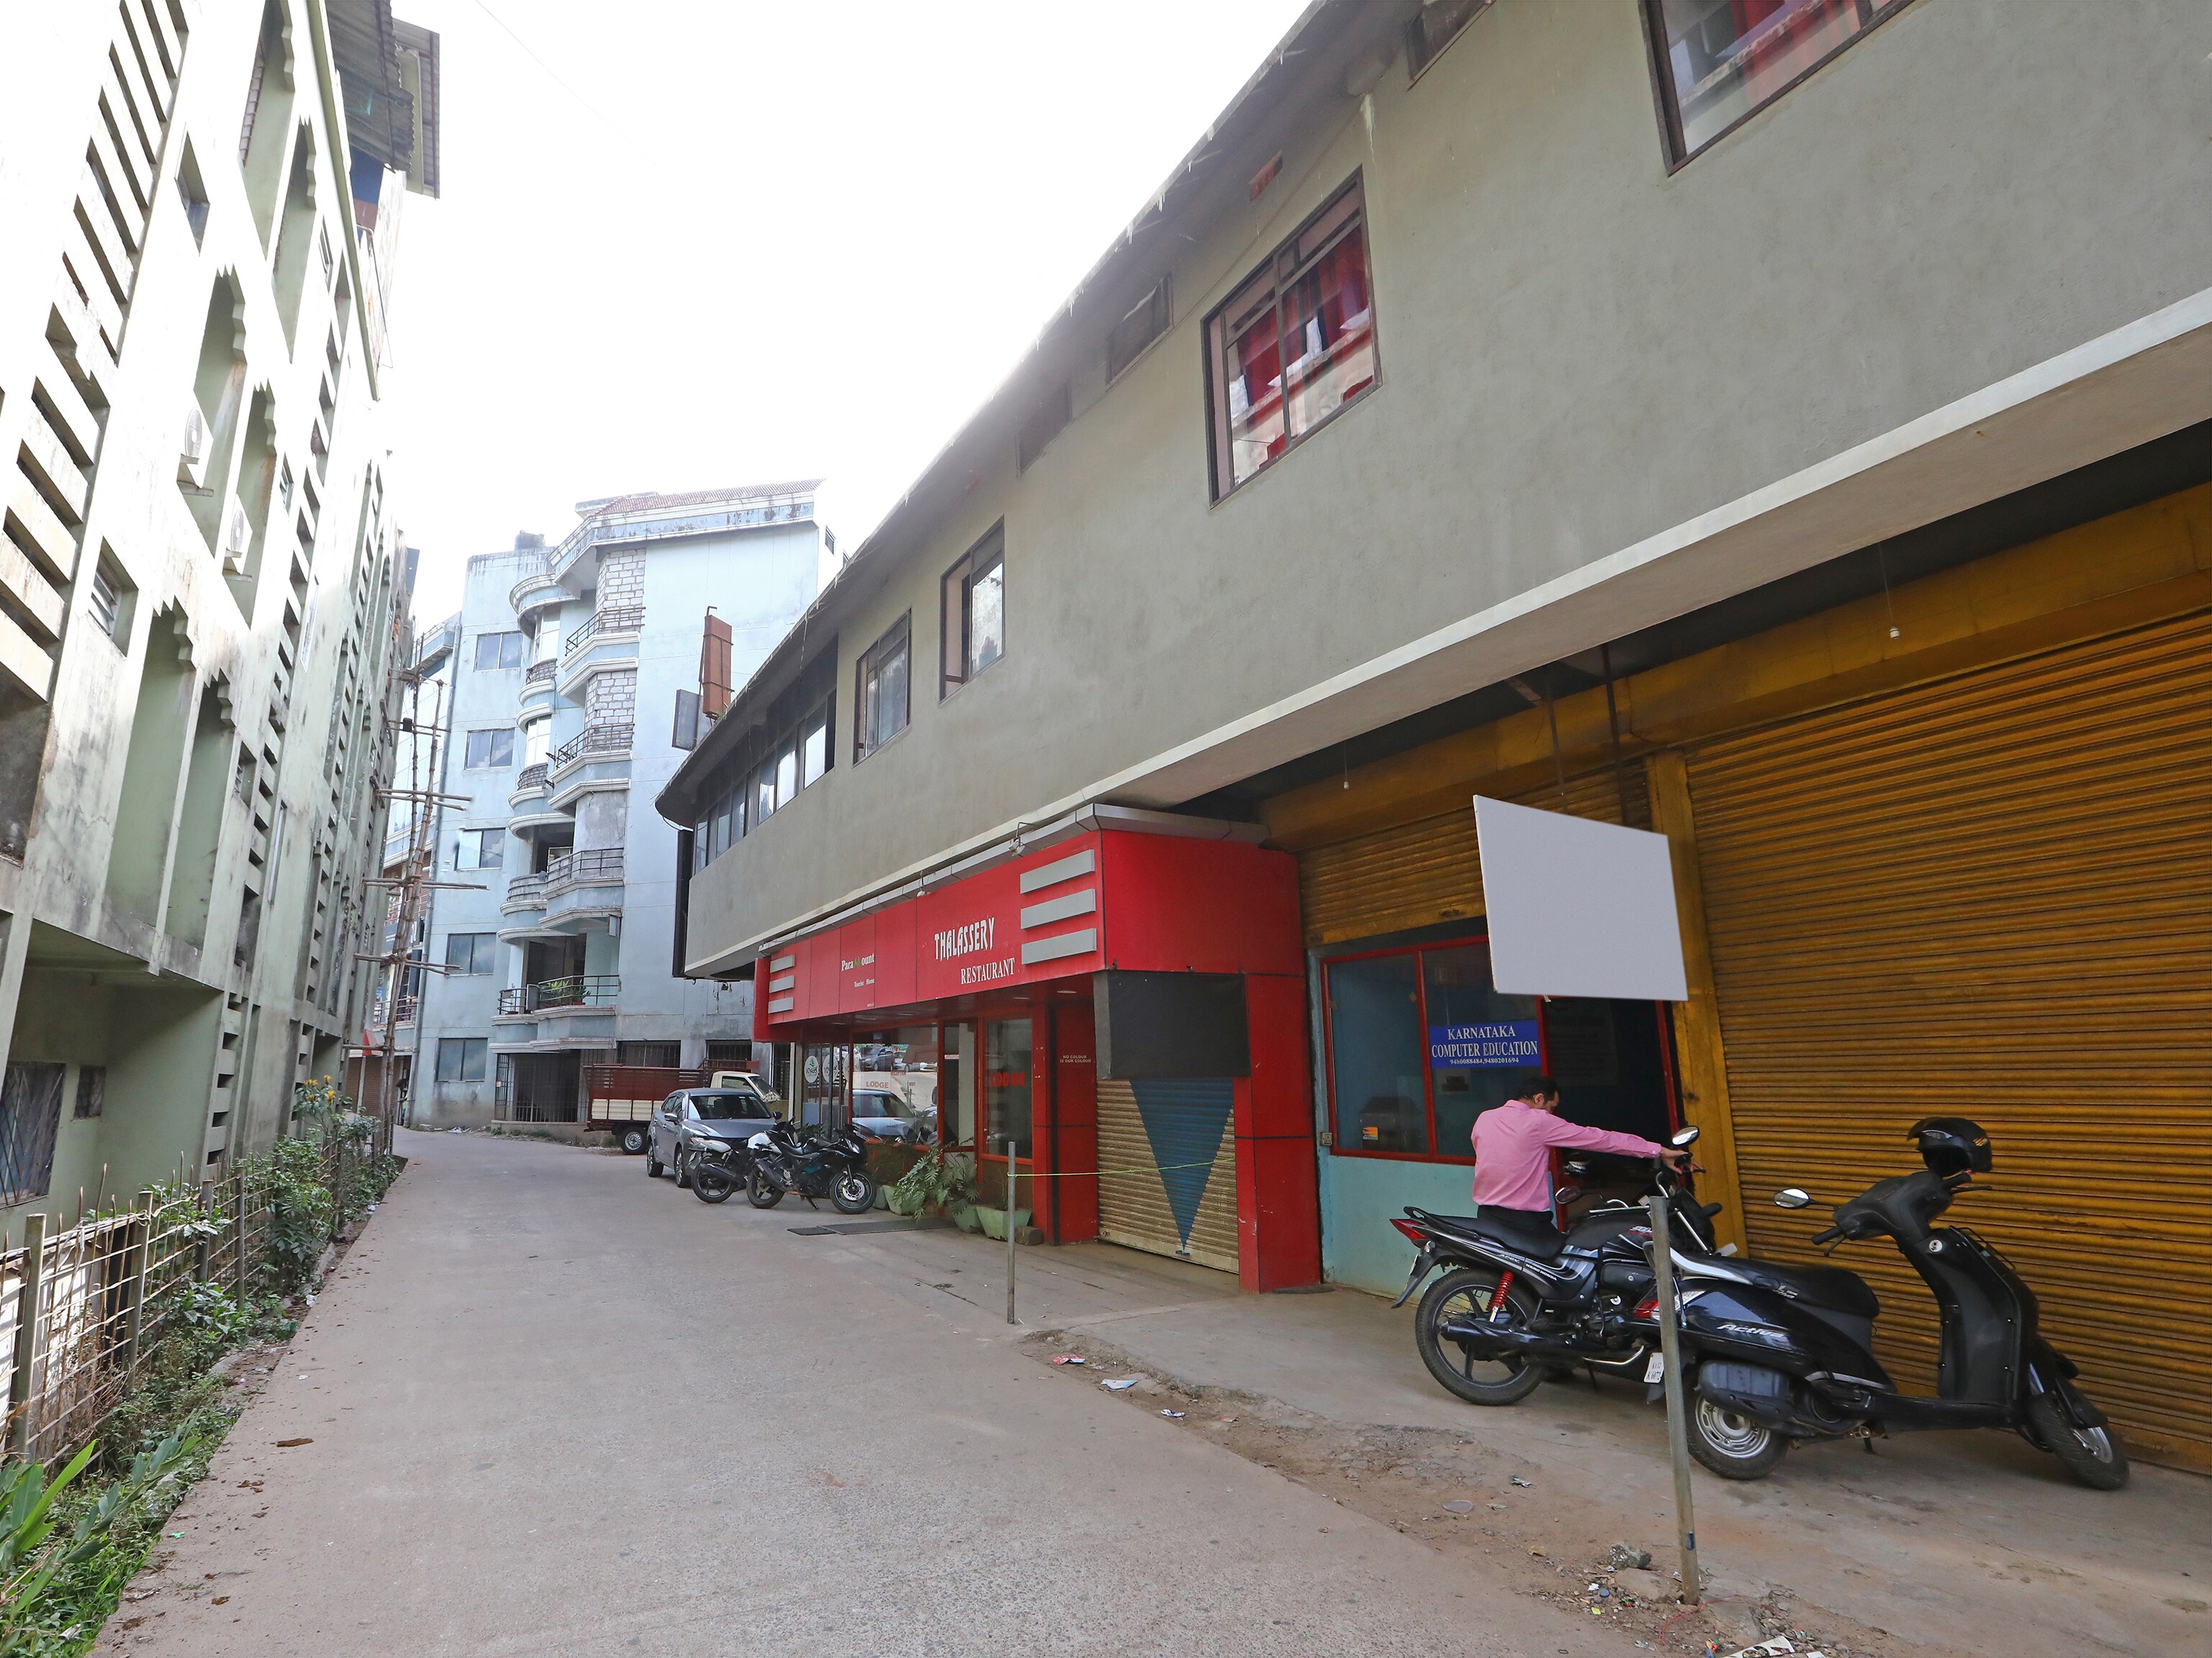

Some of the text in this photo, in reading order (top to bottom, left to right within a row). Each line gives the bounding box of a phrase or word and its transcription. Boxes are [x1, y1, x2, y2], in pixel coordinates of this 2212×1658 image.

[934, 917, 995, 961] THALASSERY
[961, 957, 1015, 984] RESTAURANT
[1447, 1025, 1516, 1041] KARNATAKA
[1431, 1041, 1538, 1058] COMPUTER EDUCATION
[866, 1080, 889, 1089] LODGE
[990, 1072, 1025, 1087] LODGE
[1526, 1263, 1558, 1281] HERO HONDA
[1716, 1323, 1785, 1338] Activa
